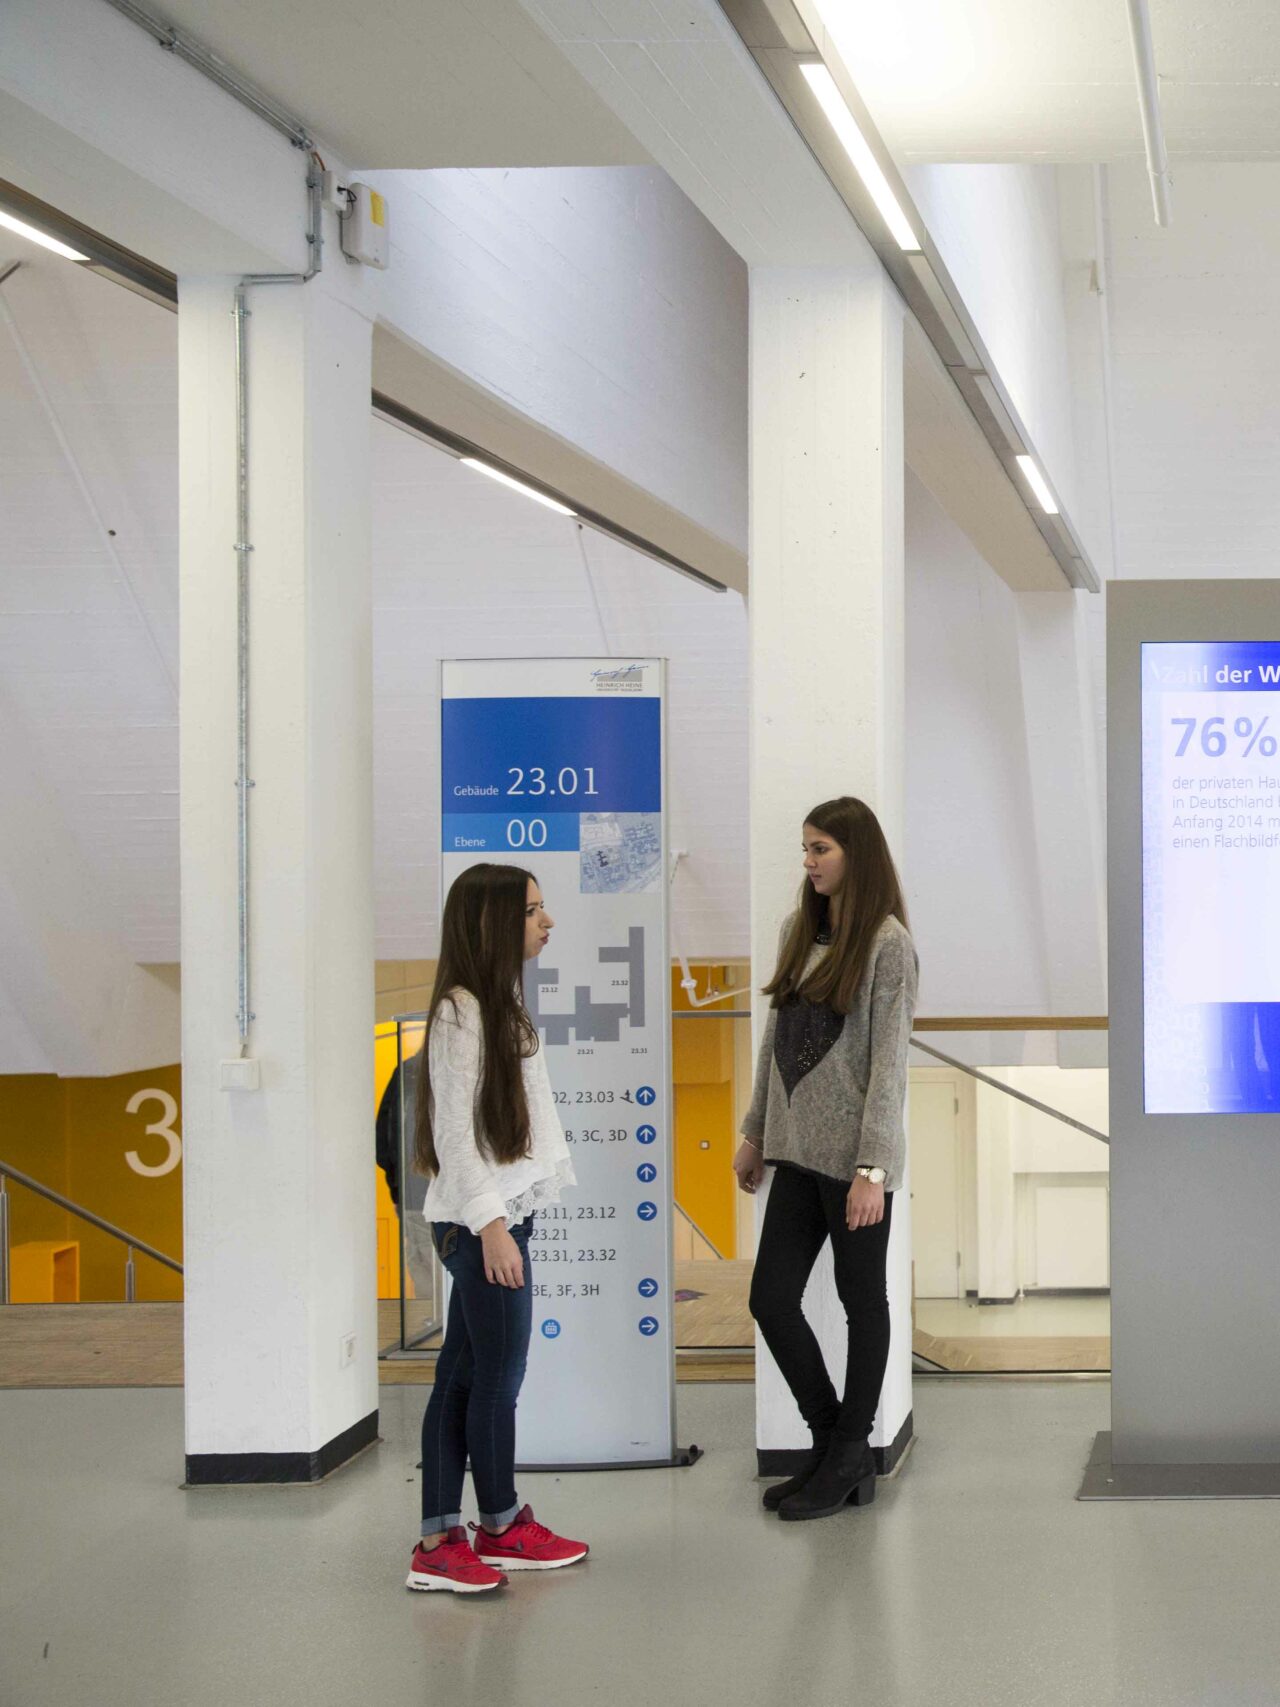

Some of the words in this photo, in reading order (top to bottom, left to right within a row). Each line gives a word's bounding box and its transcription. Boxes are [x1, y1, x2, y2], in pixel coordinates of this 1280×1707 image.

[1162, 665, 1207, 683] Zahl
[1215, 664, 1253, 683] der
[1170, 716, 1278, 758] 76%
[454, 785, 499, 796] Gebäude
[506, 767, 599, 796] 23.01
[1172, 777, 1194, 790] der
[1200, 776, 1253, 793] privaten
[1172, 796, 1185, 809] in
[1189, 795, 1274, 809] Deutschland
[1172, 815, 1223, 831] Anfang
[1227, 815, 1263, 828] 2014
[454, 836, 486, 847] Ebene
[506, 819, 548, 847] 00
[1172, 836, 1209, 849] einen
[576, 1090, 615, 1104] 23.03
[124, 1087, 182, 1178] 3
[582, 1130, 604, 1143] 3C,
[609, 1129, 628, 1141] 3D
[533, 1207, 572, 1222] 23.11,
[577, 1206, 616, 1219] 23.12
[531, 1228, 568, 1241] 23.21
[531, 1249, 573, 1264] 23.31,
[578, 1248, 616, 1262] 23.32
[532, 1285, 552, 1298] 3E,
[556, 1284, 576, 1298] 3F,
[581, 1284, 600, 1296] 3H
